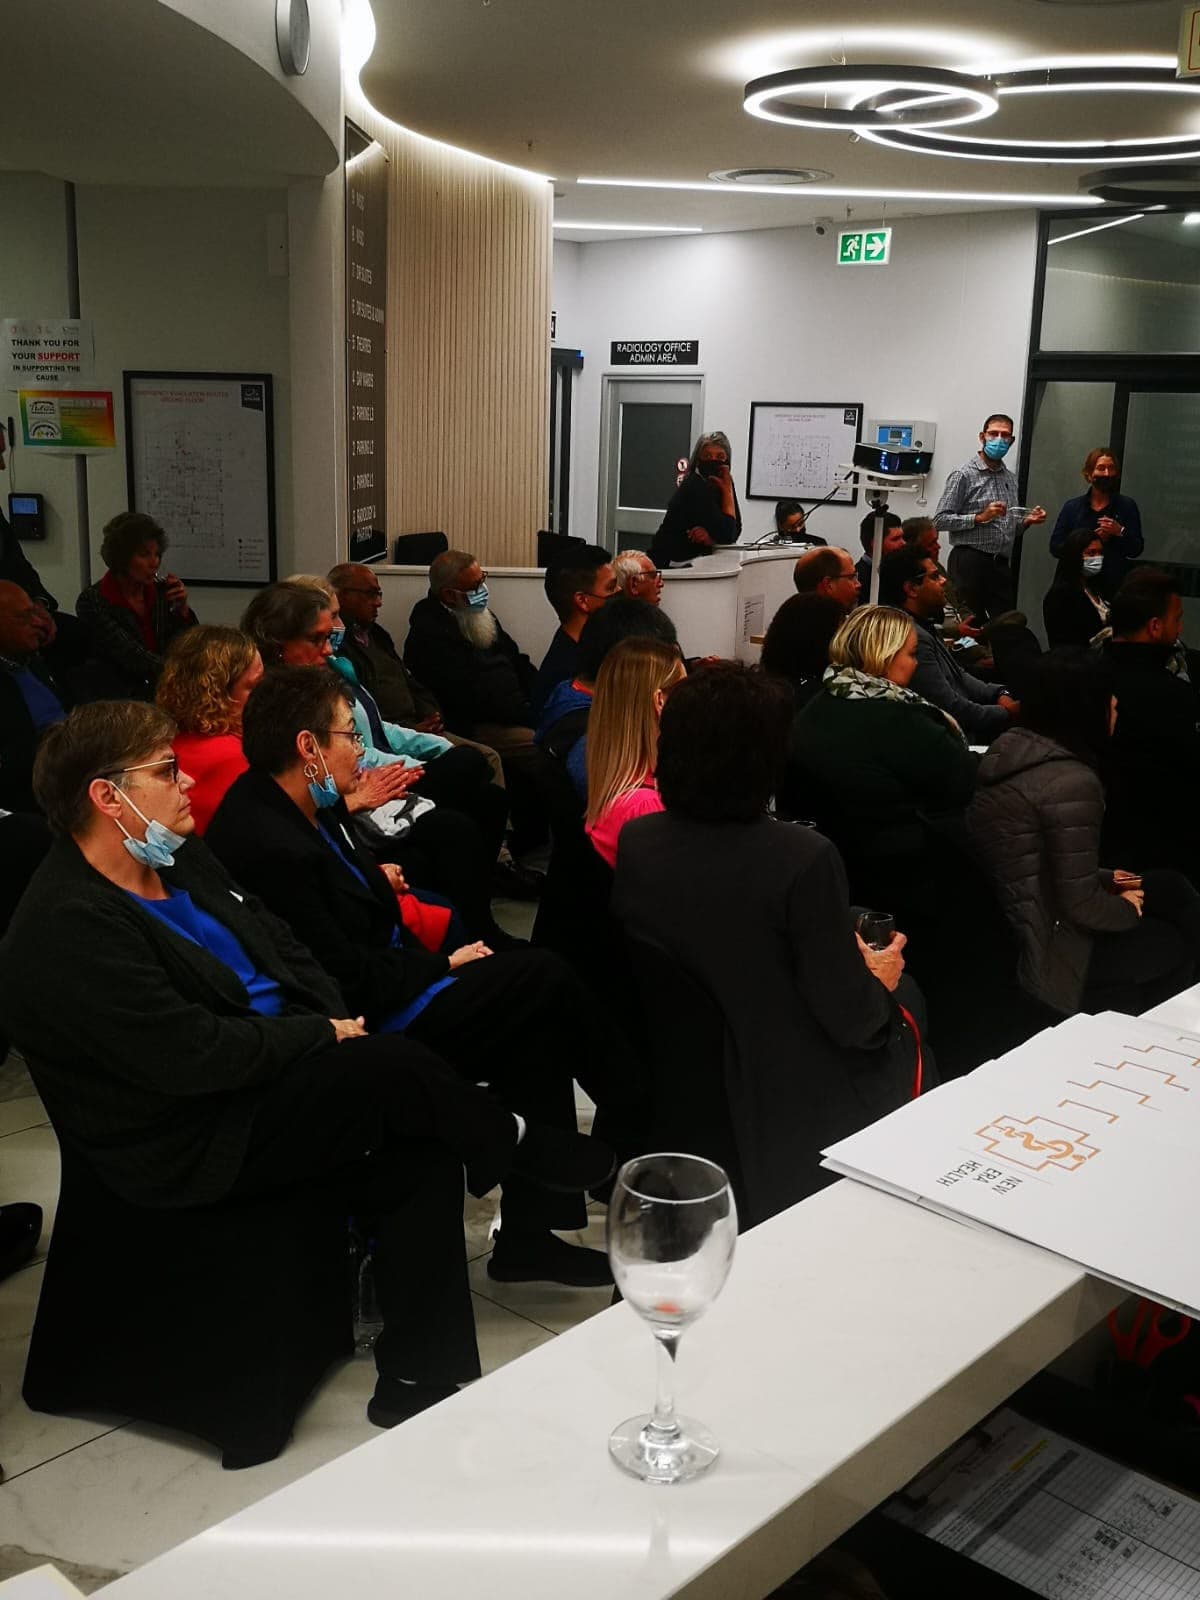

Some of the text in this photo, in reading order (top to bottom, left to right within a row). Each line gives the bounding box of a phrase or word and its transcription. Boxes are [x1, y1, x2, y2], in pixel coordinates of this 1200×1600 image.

[11, 339, 80, 347] THANK YOU FOR
[616, 342, 692, 353] RADIOLOGY OFFICE
[12, 352, 80, 361] YOUR SUPPORT
[629, 353, 678, 363] ADMIN AREA
[936, 1160, 983, 1187] HEALTH
[972, 1168, 1002, 1183] ERA
[992, 1176, 1023, 1195] NEW
